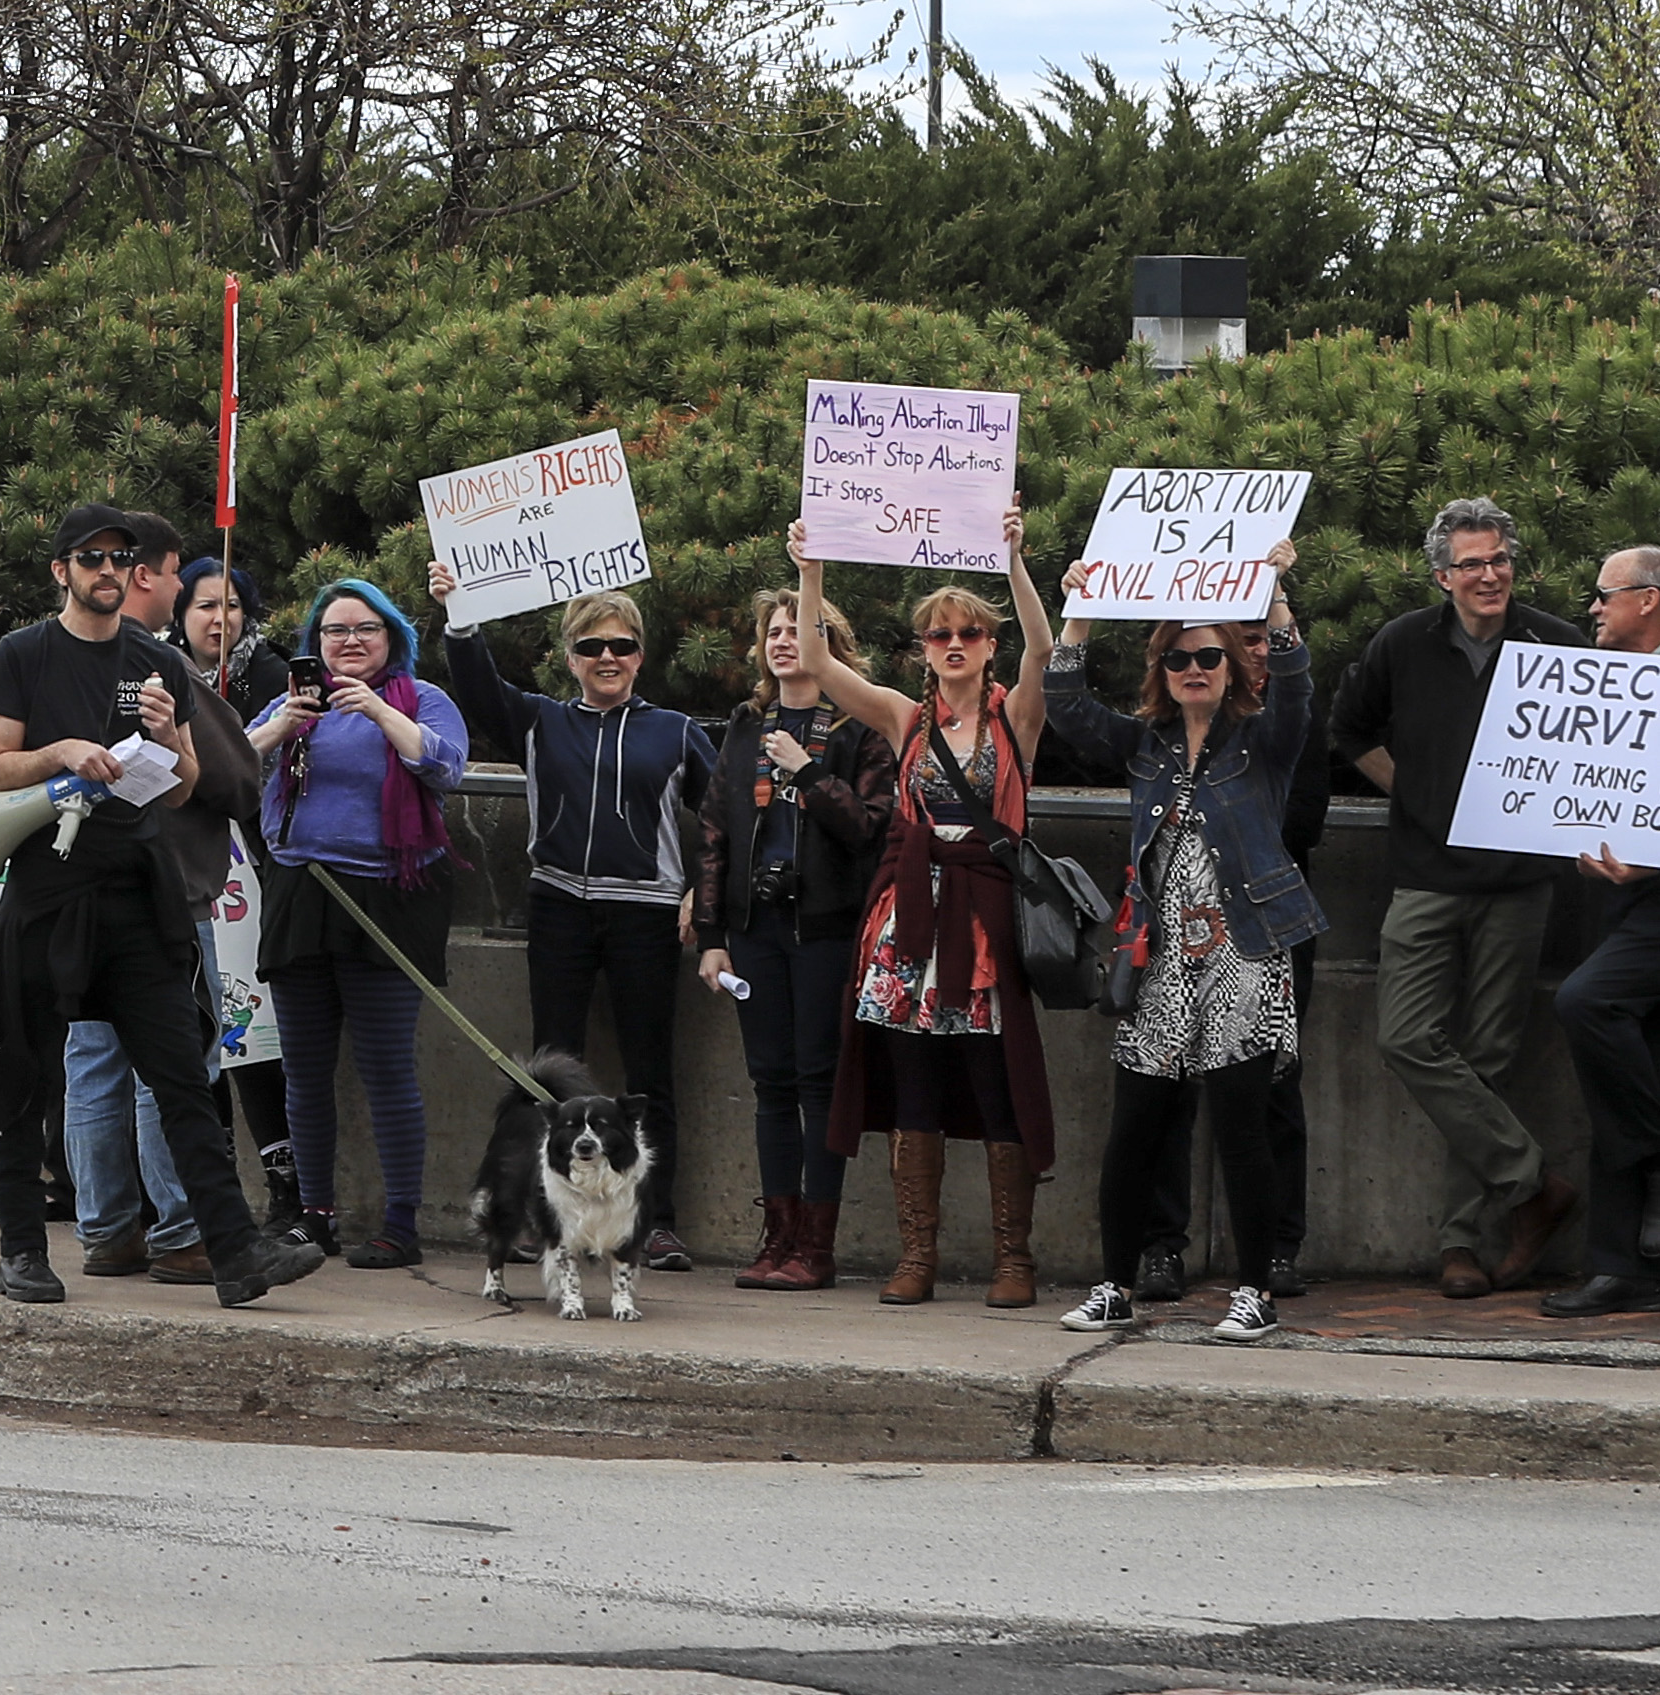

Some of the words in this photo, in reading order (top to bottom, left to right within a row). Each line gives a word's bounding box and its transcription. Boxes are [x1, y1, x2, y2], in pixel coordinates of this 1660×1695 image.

[891, 397, 963, 430] Abortion
[967, 404, 1011, 441] Illegal
[814, 436, 877, 466] Doesn't
[884, 442, 923, 474] Stop
[928, 445, 1004, 472] Abortions.
[428, 459, 534, 519] WOMEN'S
[533, 443, 623, 497] RIGHTS
[807, 476, 832, 496] It
[1108, 470, 1300, 513] ABORTION
[518, 502, 555, 525] ARE
[875, 504, 941, 534] SAFE
[911, 539, 1000, 569] Abortions.
[1153, 519, 1190, 553] IS
[1199, 519, 1233, 553] A
[451, 531, 549, 579] HUMAN
[540, 539, 645, 602] RIGHTS
[1081, 560, 1155, 600] CIVIL
[1166, 559, 1268, 601] RIGHT
[1517, 653, 1660, 700] VASEC
[1572, 763, 1647, 793] TAKING
[1503, 790, 1536, 814] OF
[1554, 796, 1622, 824] OWN
